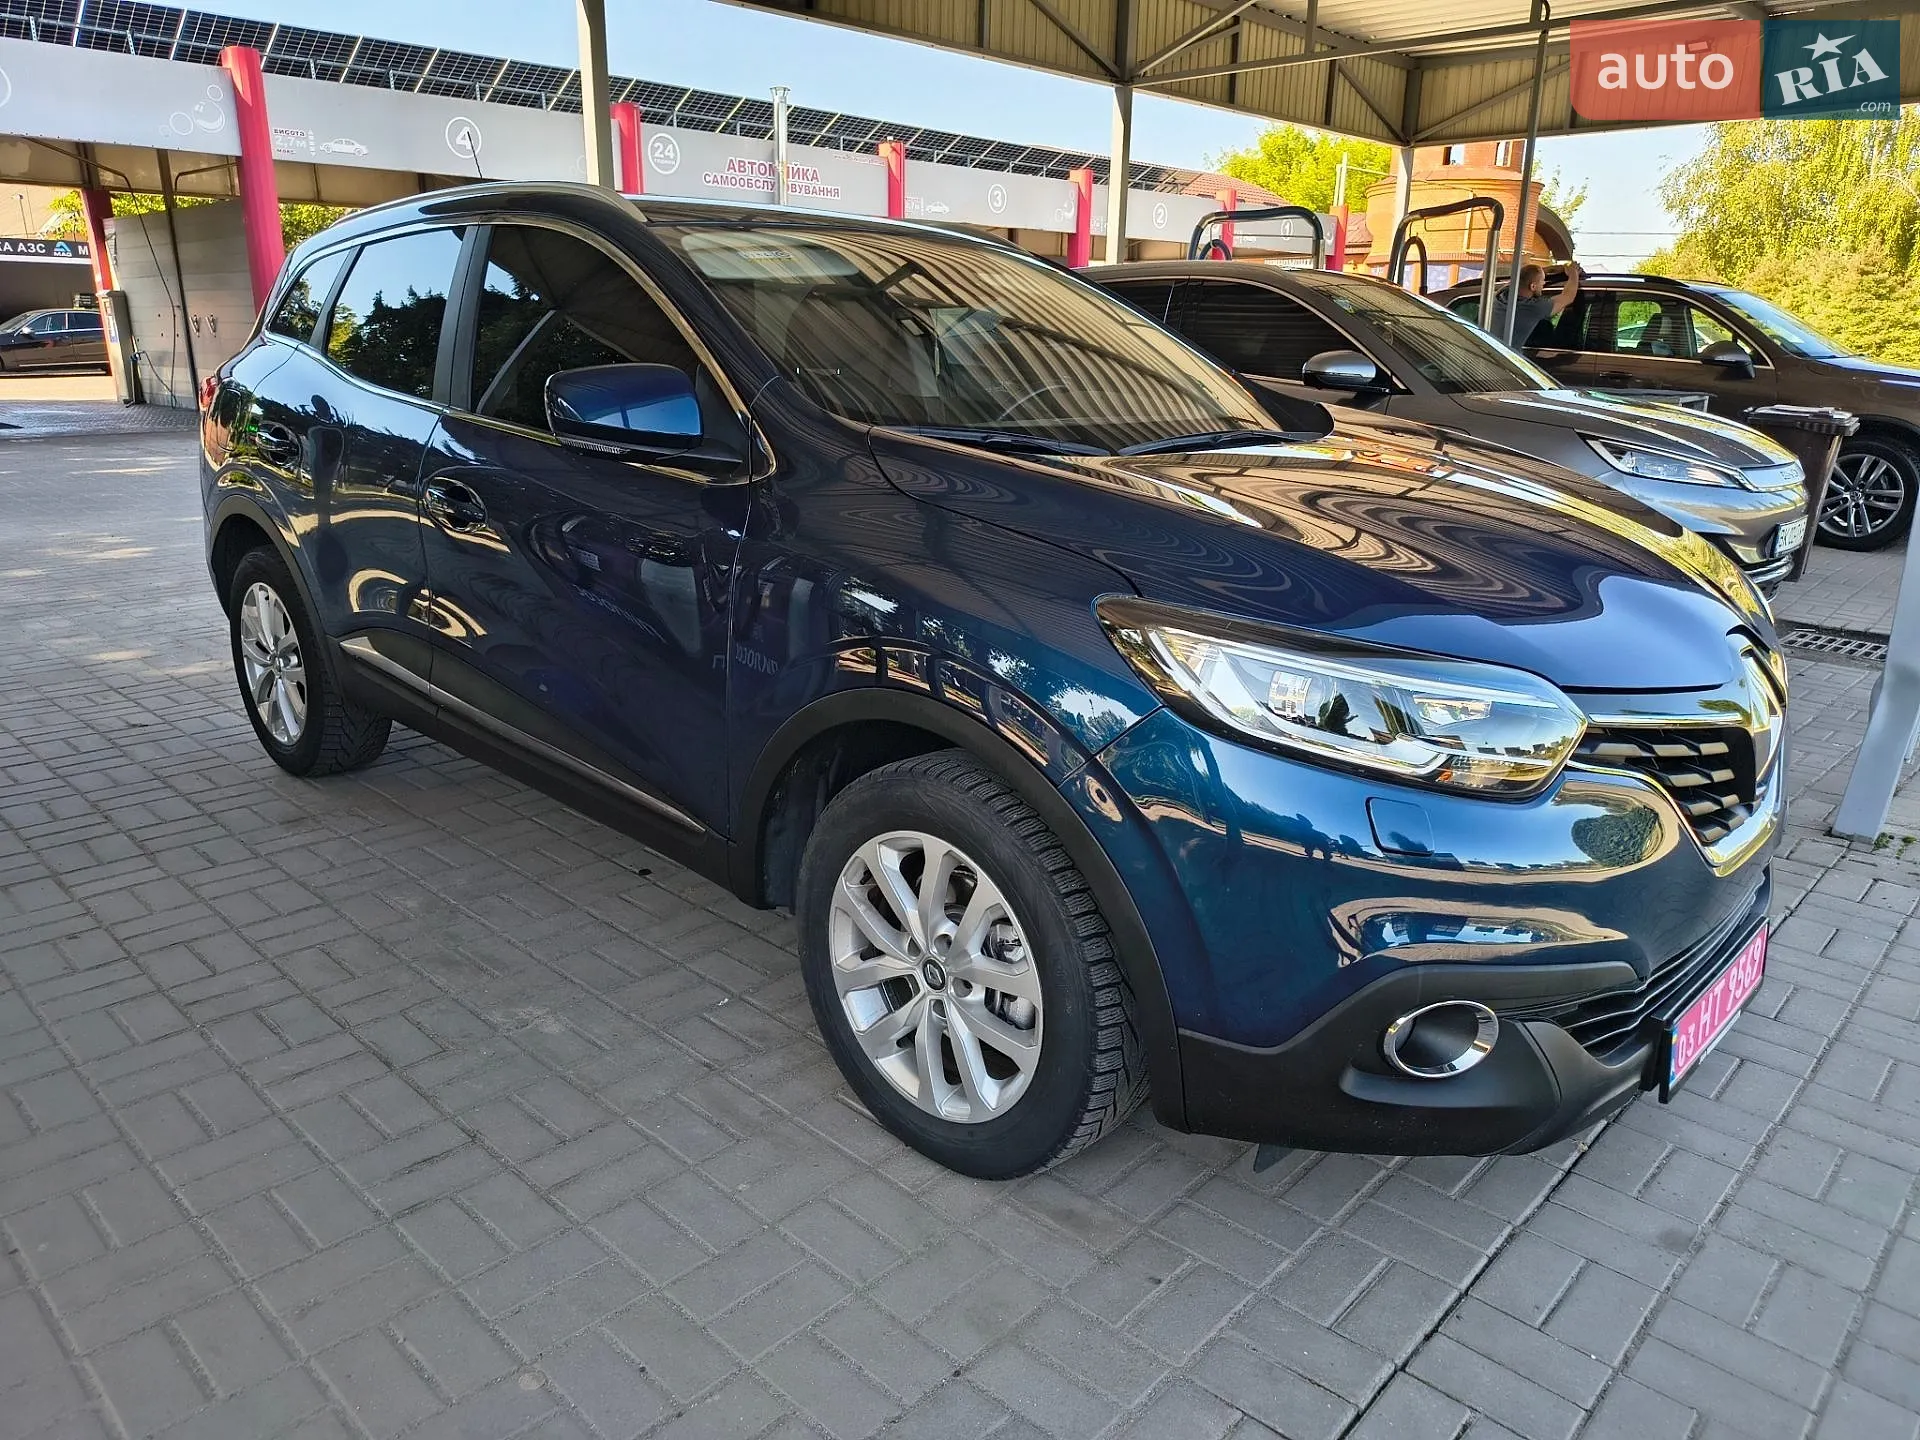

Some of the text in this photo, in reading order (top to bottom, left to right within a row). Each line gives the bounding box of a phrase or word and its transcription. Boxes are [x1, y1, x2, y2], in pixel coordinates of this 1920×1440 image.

[455, 126, 473, 150] 4
[653, 142, 675, 159] 24
[726, 158, 821, 183] АВТОМЙКА
[703, 173, 841, 199] САМООБСЛУВУВАННЯ
[993, 190, 1003, 208] 3
[1156, 208, 1165, 224] 2
[17, 242, 46, 254] АЗС
[1677, 1024, 1697, 1068] 03
[1697, 977, 1726, 1046] HT
